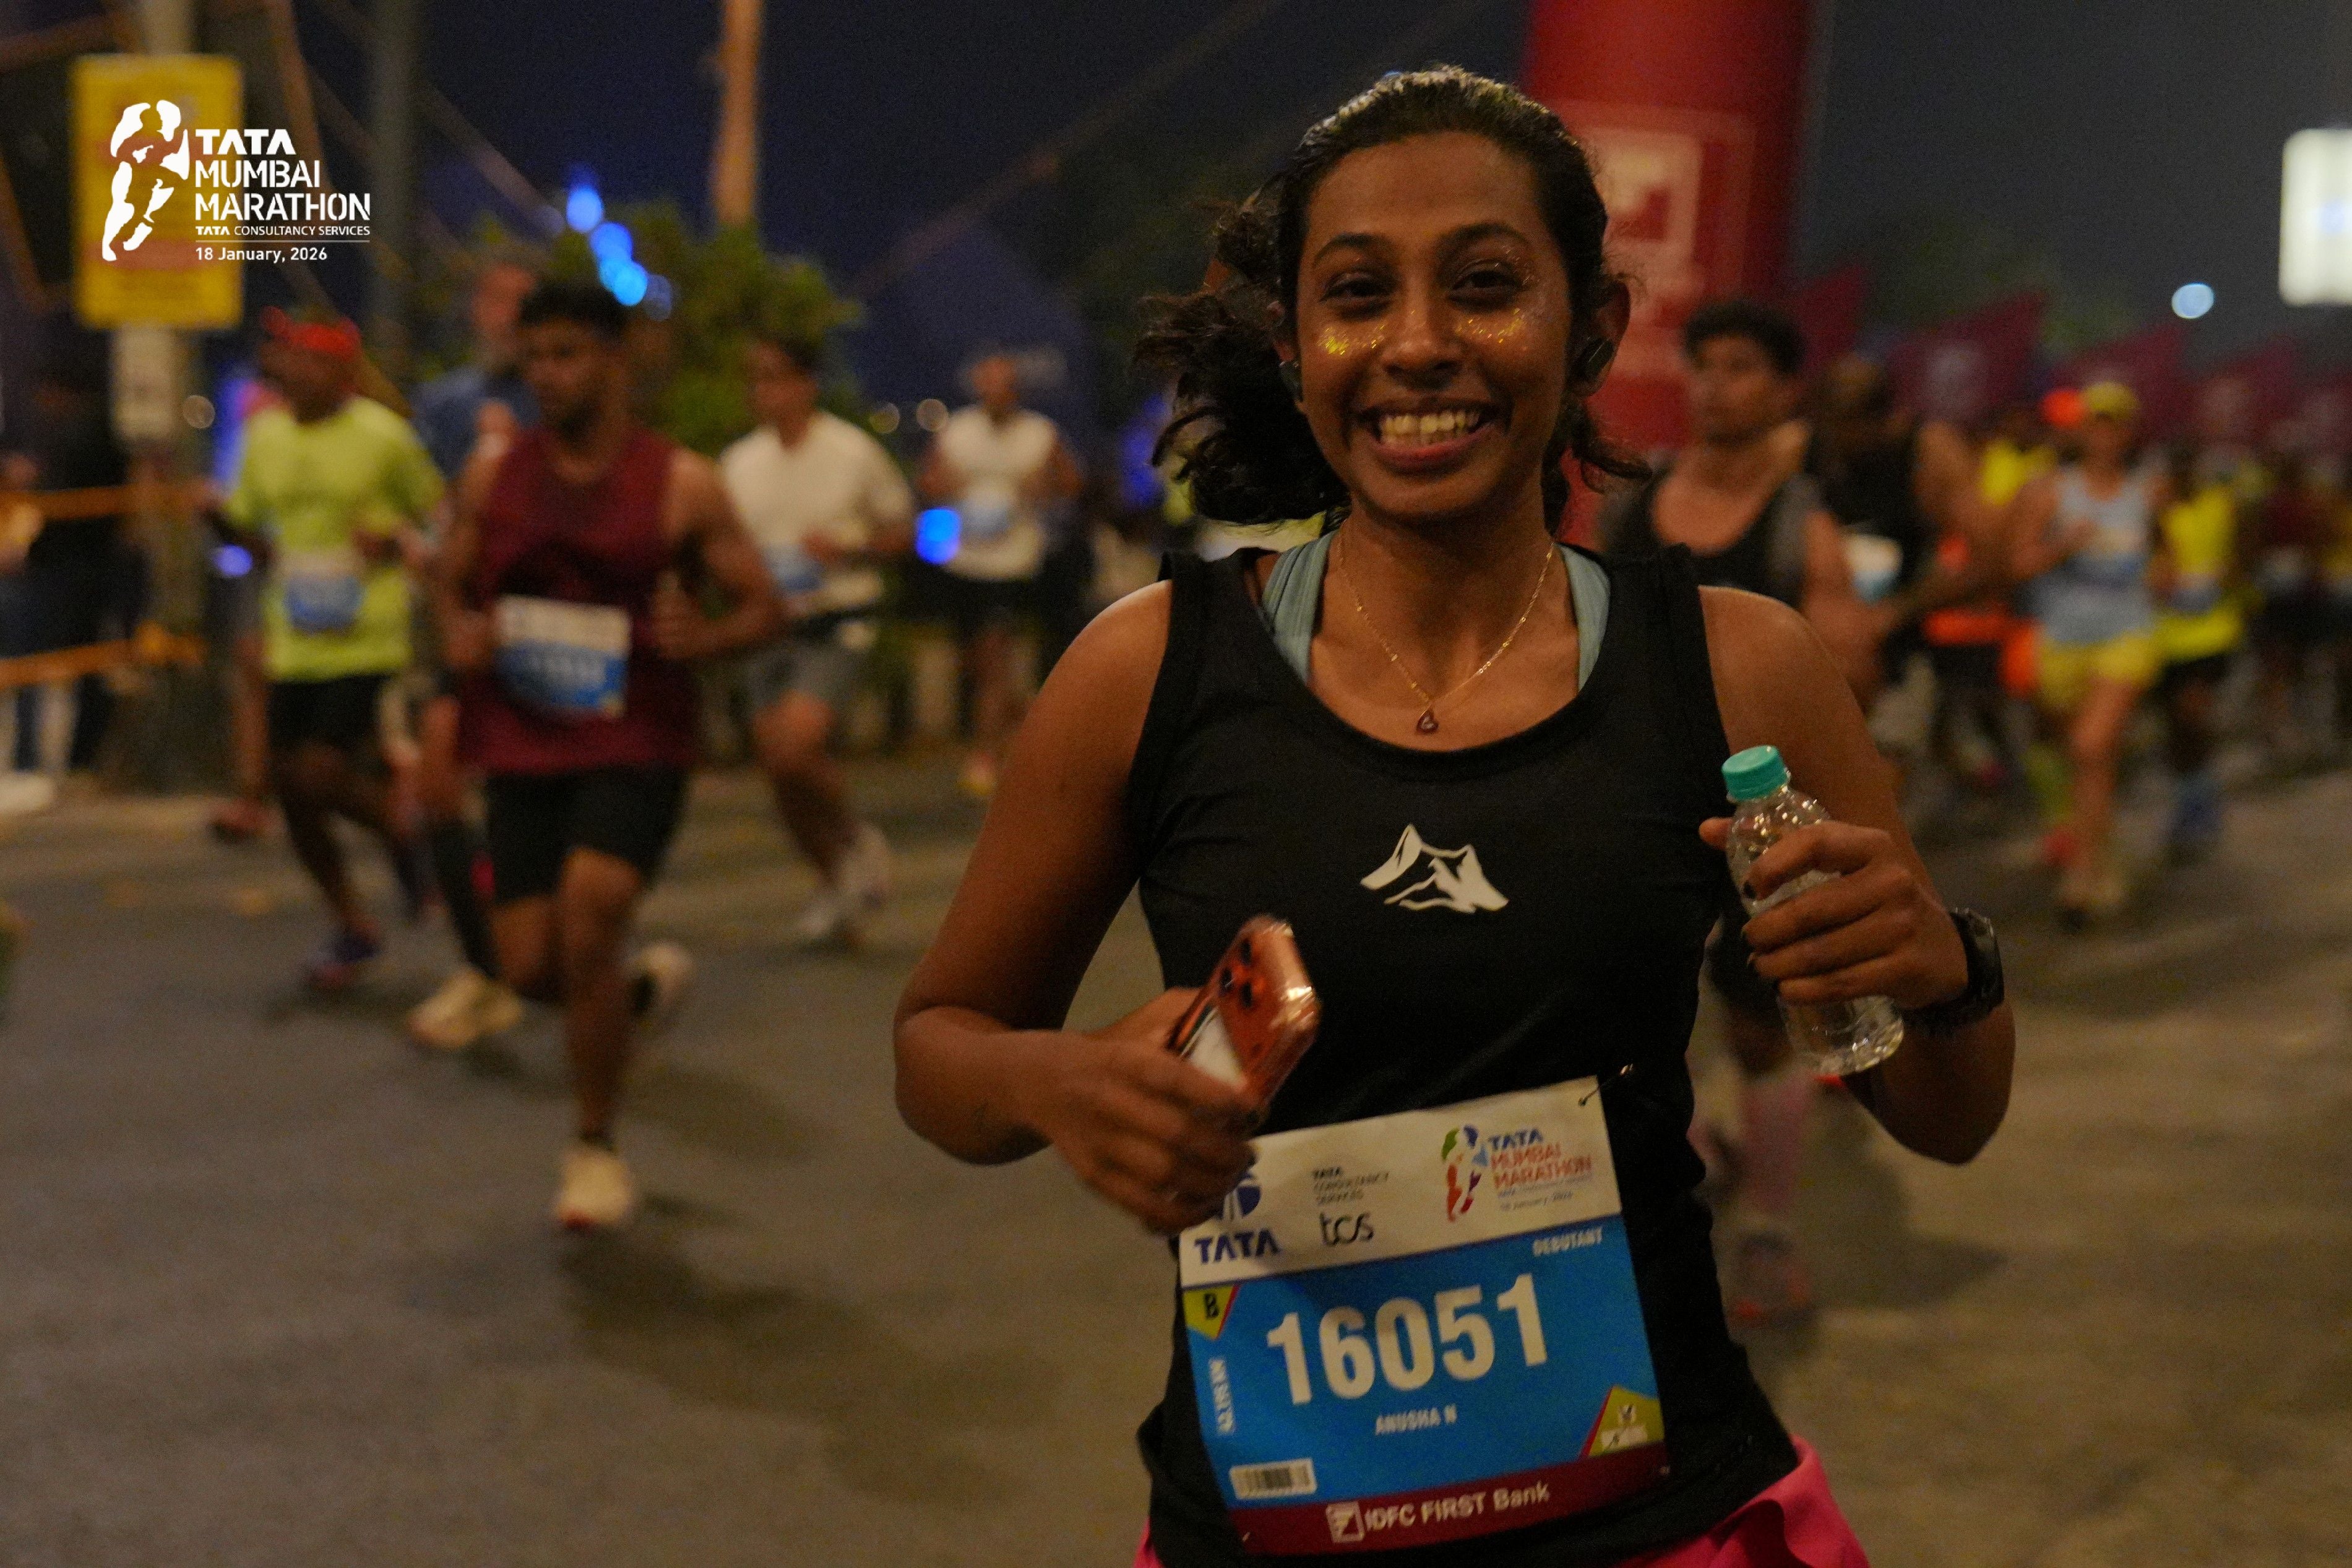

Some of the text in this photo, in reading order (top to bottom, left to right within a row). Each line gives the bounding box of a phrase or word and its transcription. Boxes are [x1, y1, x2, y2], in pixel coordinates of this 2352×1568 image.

[1488, 1127, 1544, 1151] TATA
[1491, 1142, 1562, 1170] MUMBAI
[1492, 1154, 1593, 1189] MARATHON
[1194, 1227, 1282, 1265] TATA
[1319, 1212, 1376, 1247] tcs
[1531, 1226, 1603, 1257] DEBUTANT
[1203, 1292, 1220, 1319] B
[1266, 1273, 1548, 1405] 16051
[1375, 1407, 1442, 1436] ANUSHA
[1363, 1480, 1550, 1532] IDFC FIRST Bank
